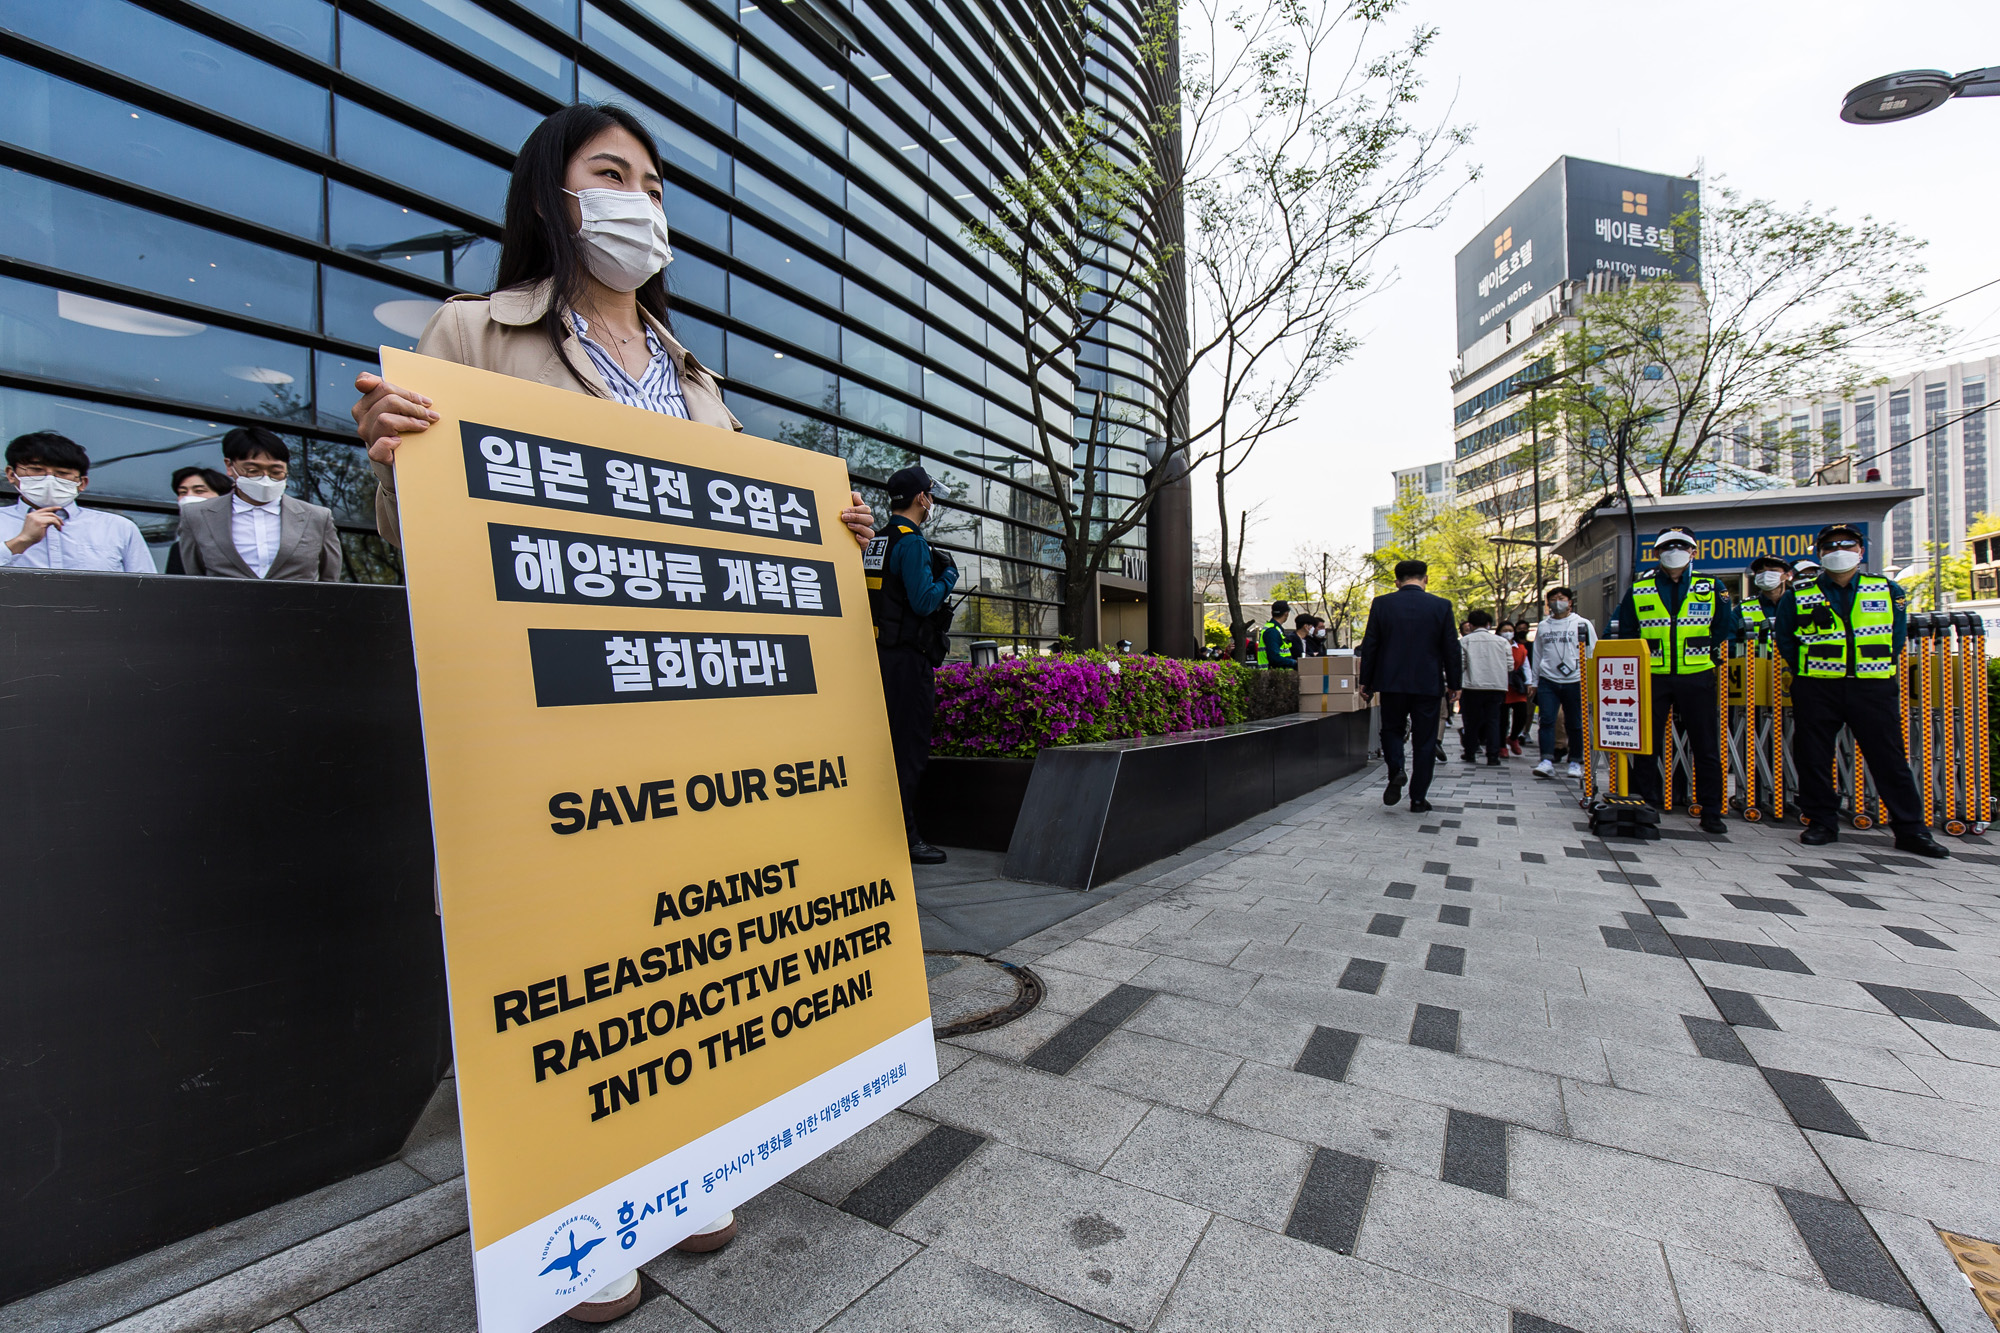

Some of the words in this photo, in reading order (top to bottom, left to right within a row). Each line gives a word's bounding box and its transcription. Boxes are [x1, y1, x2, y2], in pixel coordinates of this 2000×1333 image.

[1595, 218, 1675, 252] 베이튼호텔
[1478, 239, 1533, 297] 베이튼호텔
[1596, 259, 1637, 274] BAITON
[1479, 300, 1506, 326] BAITON
[1507, 280, 1533, 306] HOTEL
[479, 435, 589, 504] 일본
[605, 459, 694, 520] 원전
[707, 479, 812, 536] 오염수
[510, 535, 707, 603] 해양방류
[718, 557, 824, 610] 계획을
[864, 558, 882, 567] POLICE
[1123, 554, 1147, 582] TWI
[1692, 534, 1813, 560] NFORMATION
[605, 636, 789, 693] 철회하라!
[1601, 678, 1636, 691] 통행로
[548, 779, 678, 835] SAVE
[686, 768, 769, 812] OUR
[773, 755, 848, 798] SEA!
[653, 859, 800, 926] AGAINST
[493, 927, 732, 1033] RELEASING
[737, 878, 896, 952] FUKUSHIMA
[532, 952, 801, 1083] RADIOACTIVE
[804, 921, 892, 975] WATER
[588, 1048, 693, 1122] INTO
[698, 1015, 766, 1070] THE
[770, 969, 873, 1040] OCEAN!
[616, 1179, 689, 1250] 흥사단
[702, 1149, 755, 1194] 동아시아
[757, 1127, 793, 1161] 평화를
[796, 1113, 818, 1139] 위한
[820, 1089, 861, 1123] 대일행동
[862, 1062, 907, 1099] 특별위원회
[541, 1236, 555, 1261] YOUNG
[554, 1215, 579, 1236] KOREAN
[579, 1214, 602, 1231] ACADEMY
[555, 1285, 576, 1296] SINCE
[579, 1268, 596, 1287] 1913
